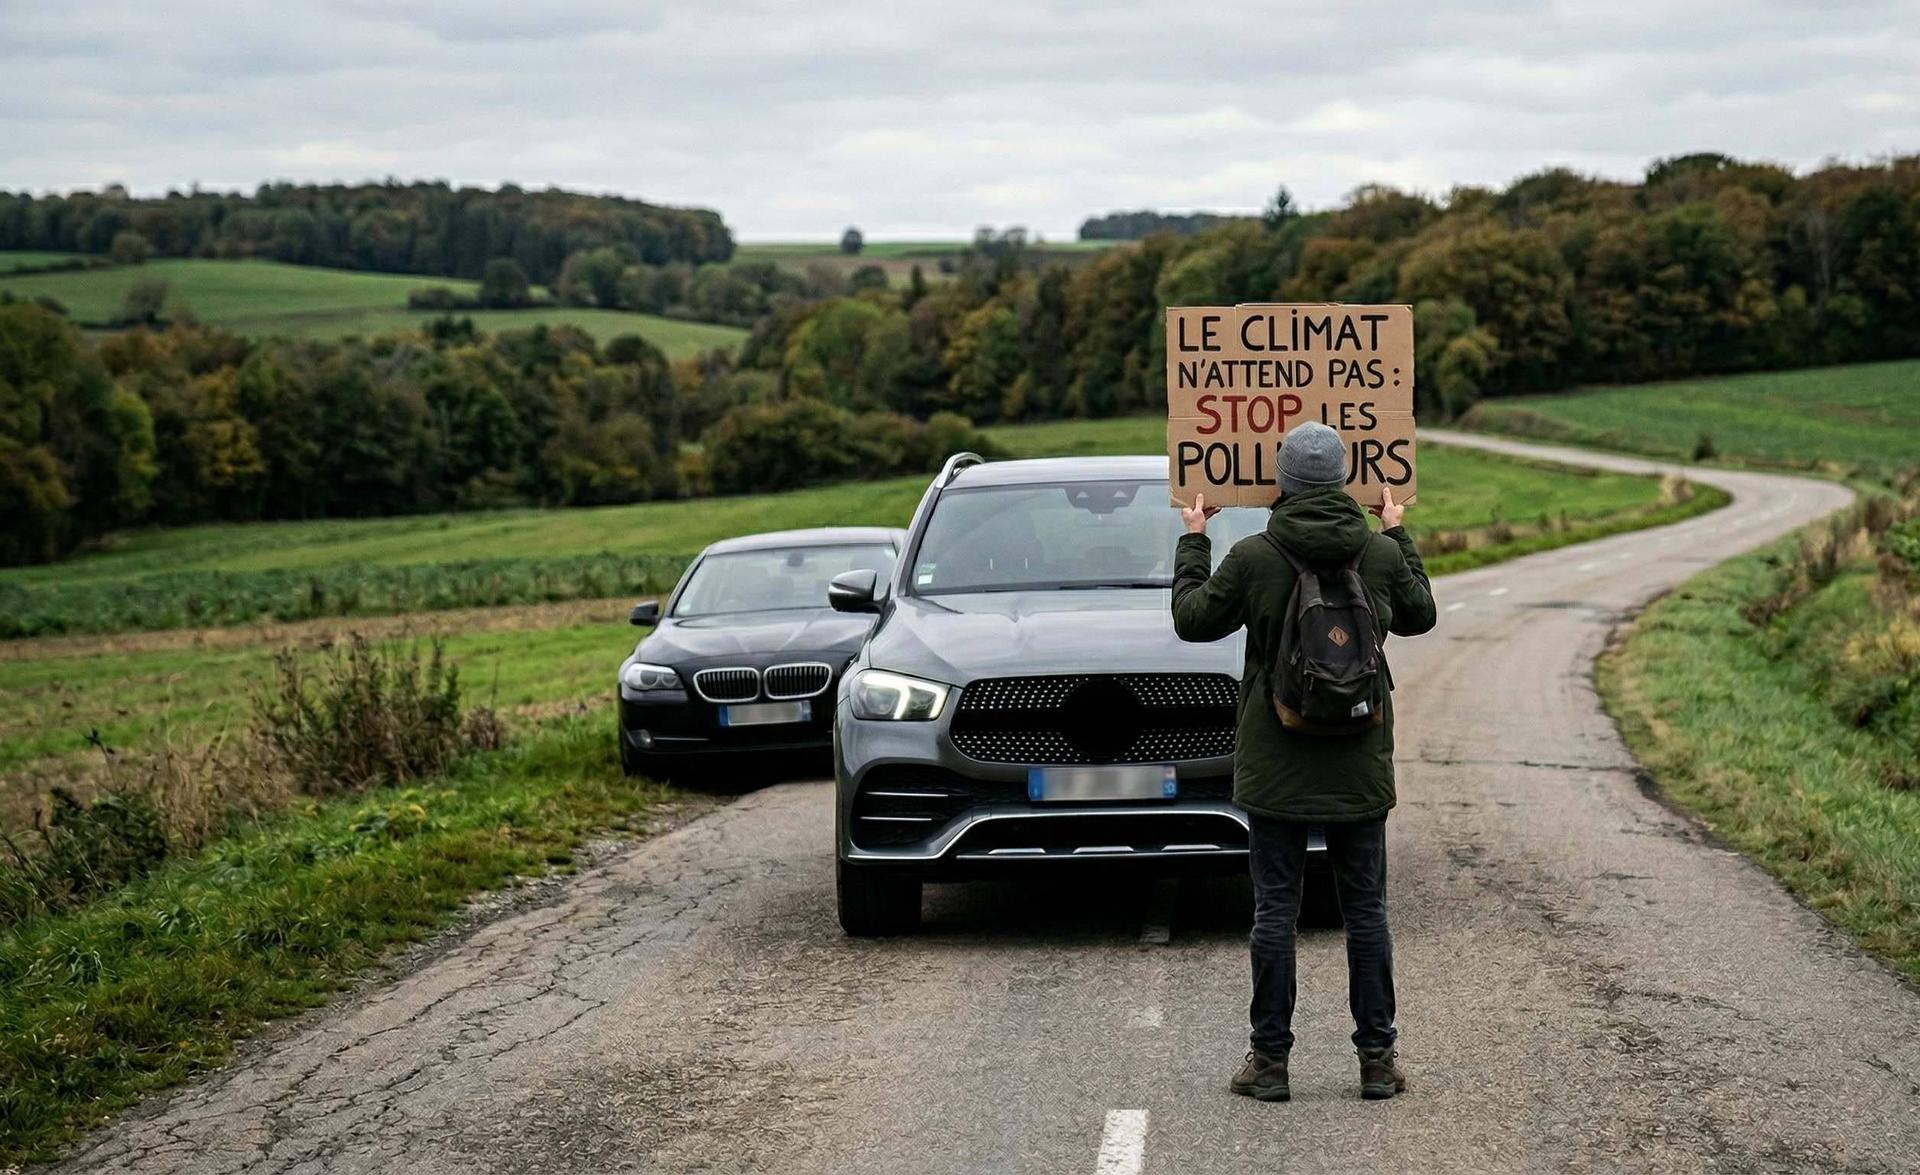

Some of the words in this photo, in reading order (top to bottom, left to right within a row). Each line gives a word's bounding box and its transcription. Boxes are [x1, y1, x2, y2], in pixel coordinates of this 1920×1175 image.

[1178, 315, 1221, 352] LE
[1178, 358, 1314, 389] N'ATTEND
[1196, 393, 1303, 435] STOP
[1321, 402, 1378, 431] LES
